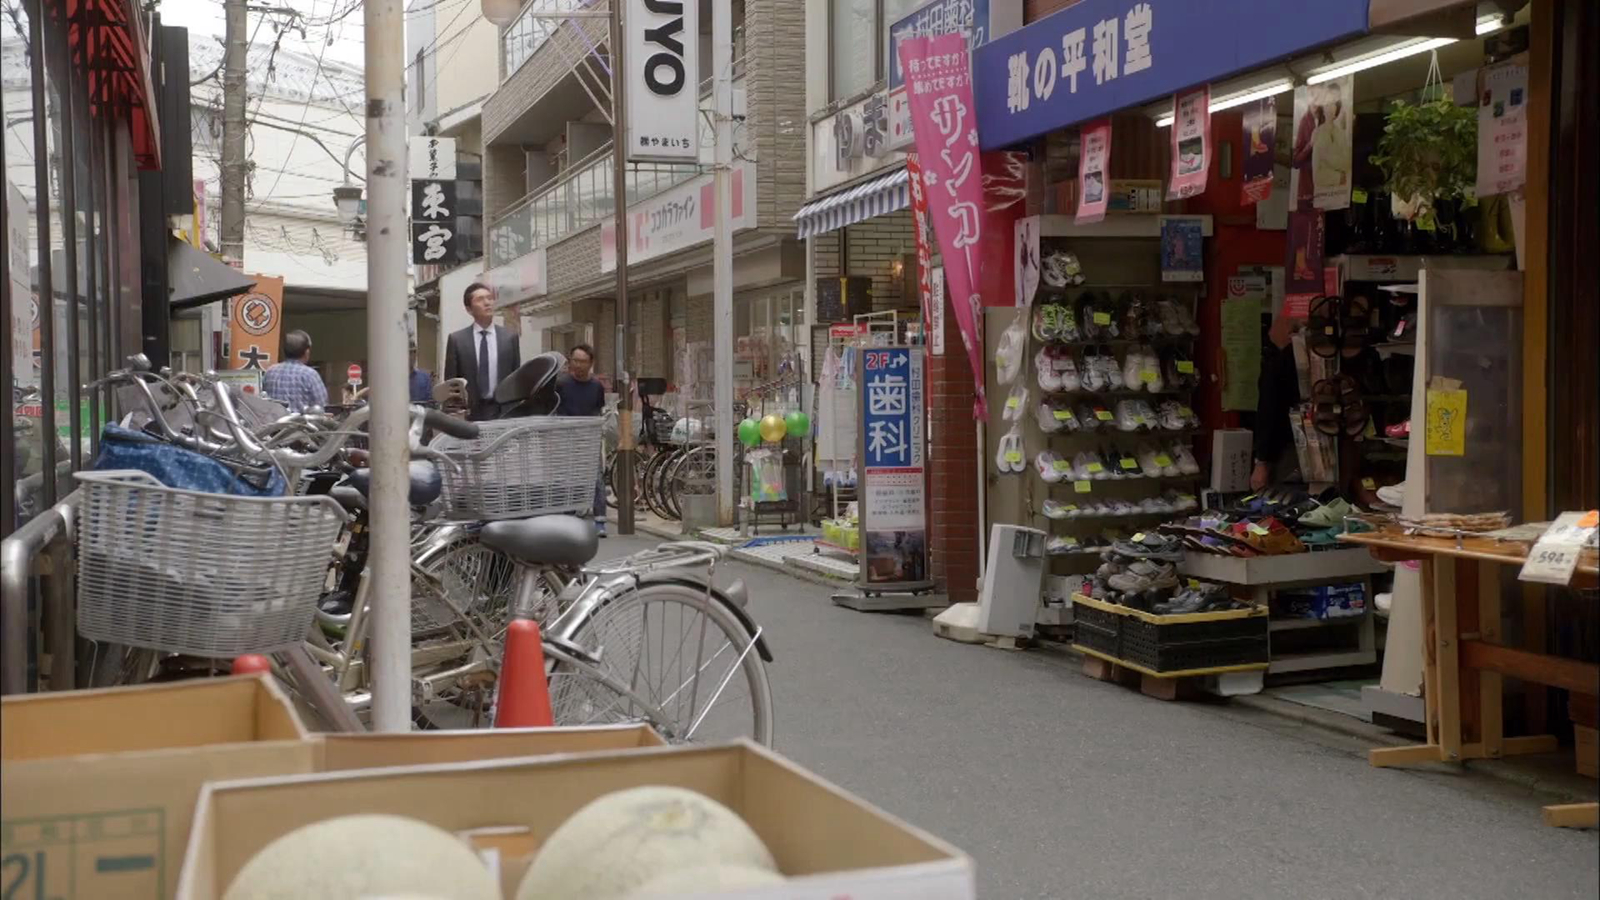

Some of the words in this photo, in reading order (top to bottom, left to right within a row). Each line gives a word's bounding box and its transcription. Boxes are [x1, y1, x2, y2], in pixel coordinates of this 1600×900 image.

[1006, 3, 1154, 114] 靴の平和堂
[866, 352, 890, 370] 2F
[866, 373, 908, 462] 歯科
